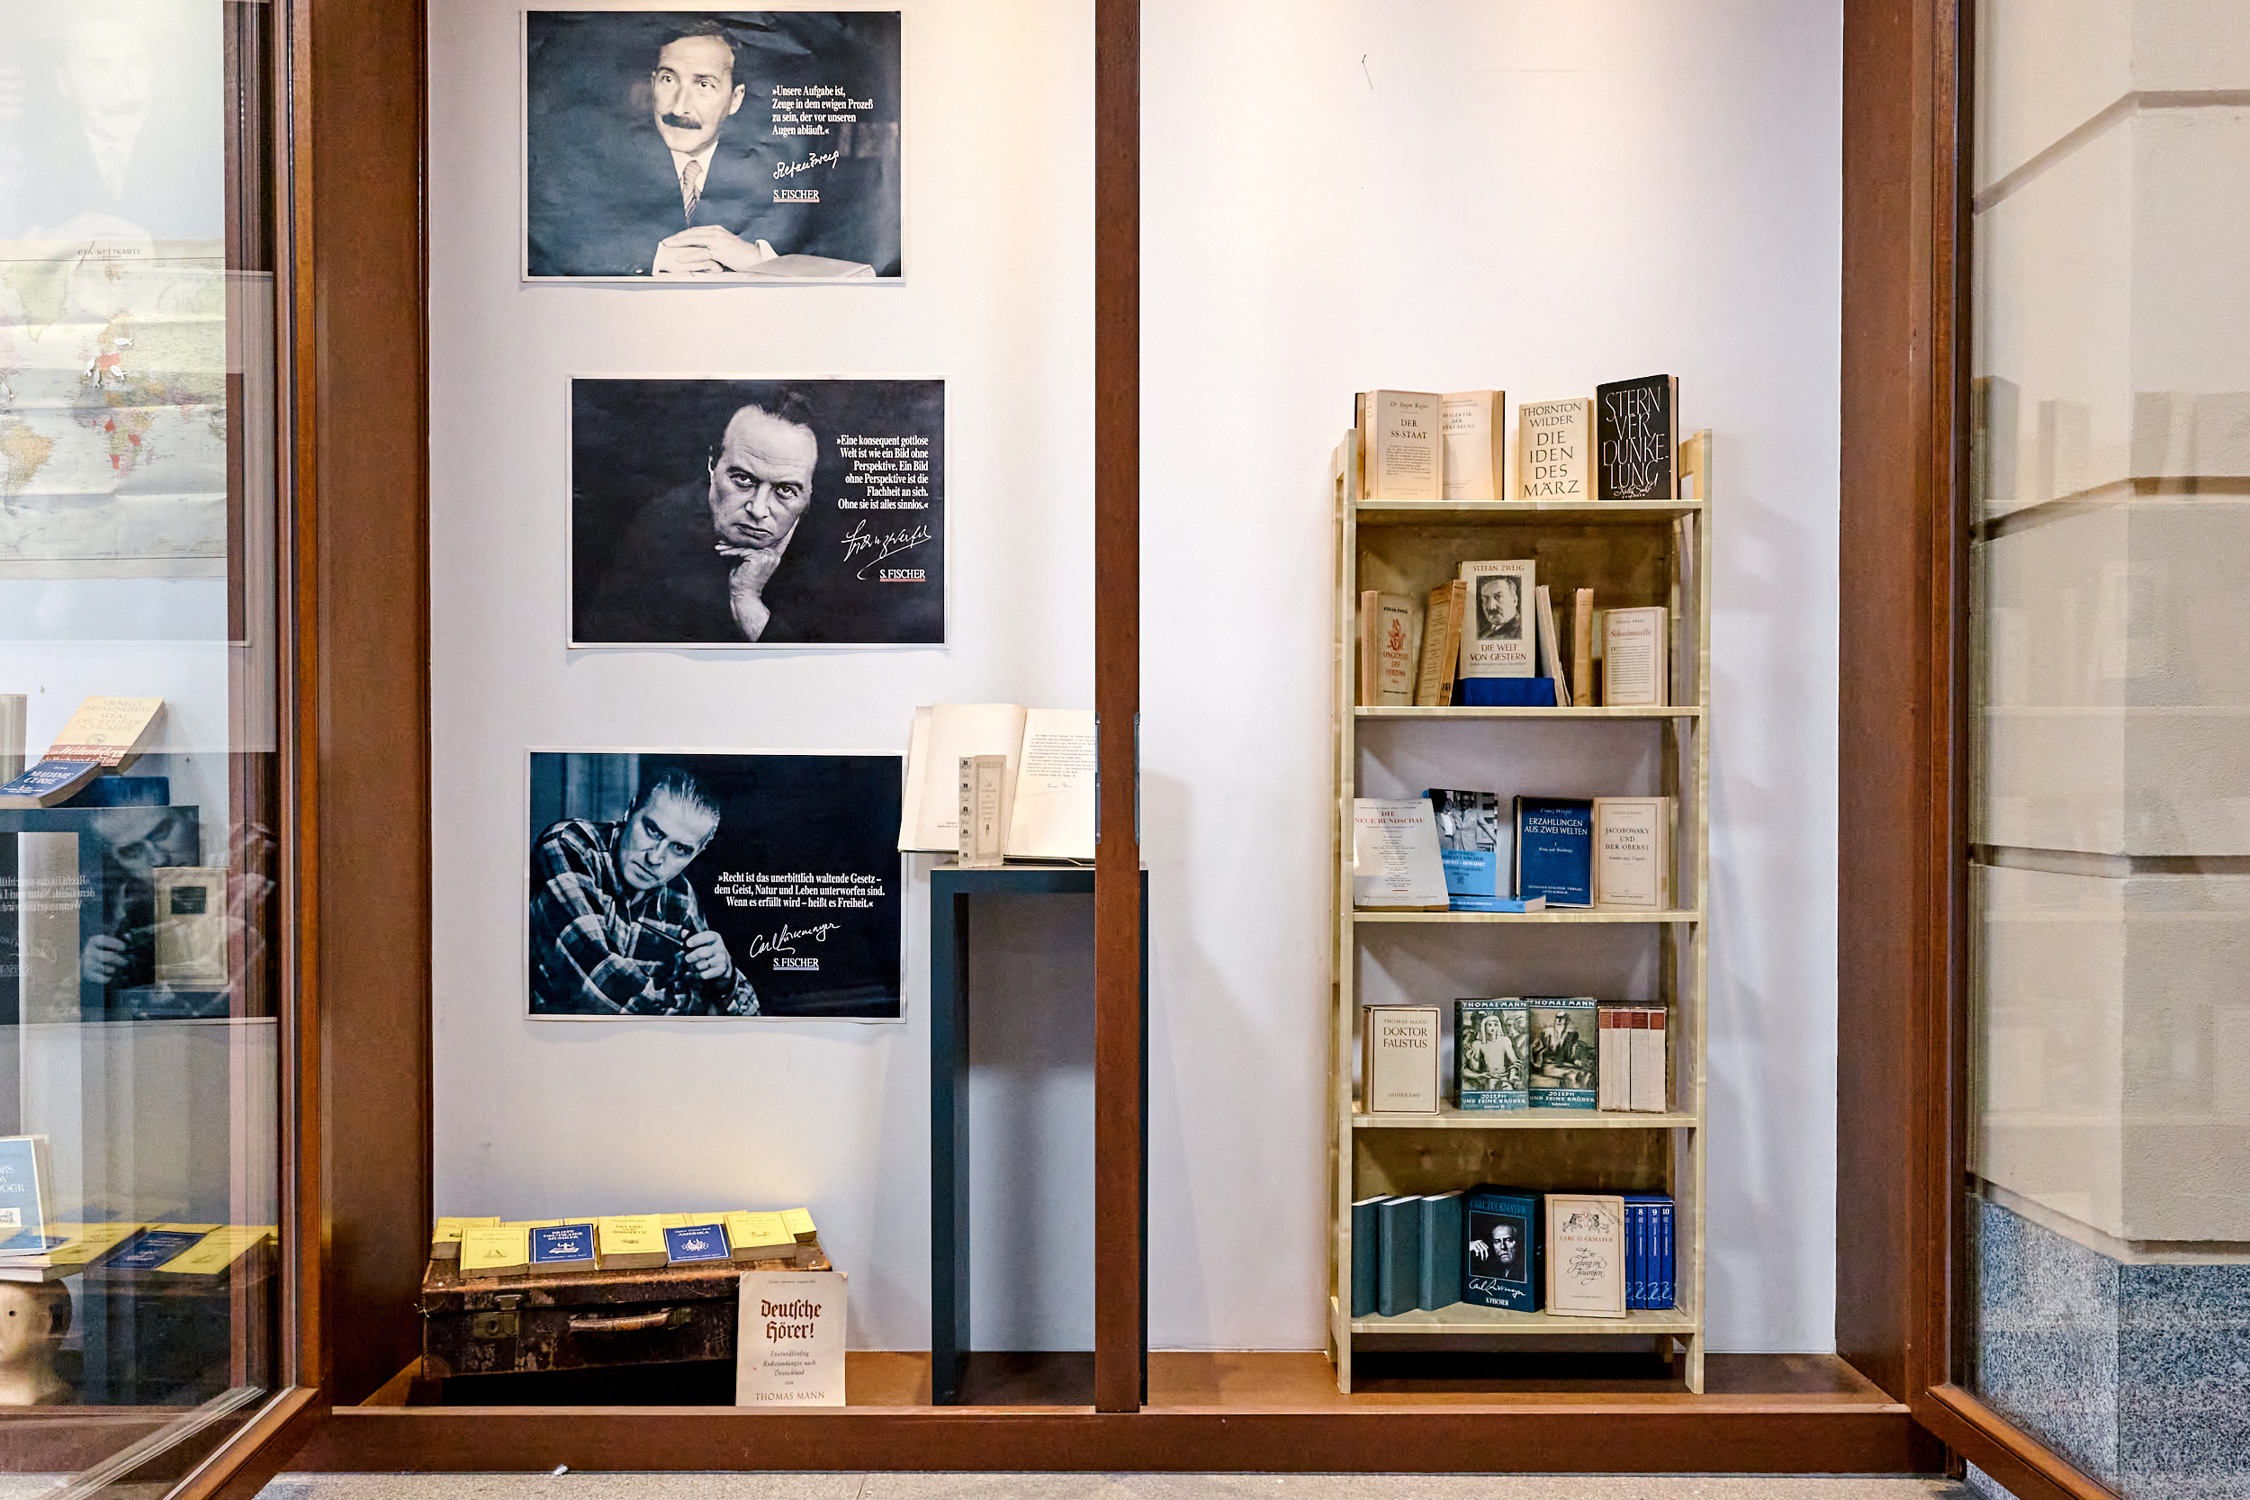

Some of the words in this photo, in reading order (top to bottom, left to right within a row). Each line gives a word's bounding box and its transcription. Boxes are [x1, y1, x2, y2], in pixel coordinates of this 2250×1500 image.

[772, 85, 801, 96] »Unsere
[803, 85, 834, 98] Aufgabe
[834, 86, 846, 97] ist,
[772, 100, 795, 111] Zeuge
[796, 100, 803, 109] in
[804, 100, 820, 109] dem
[822, 100, 846, 111] ewigen
[848, 100, 874, 109] Prozeß
[772, 114, 780, 122] zu
[782, 112, 798, 123] sein,
[800, 112, 812, 122] der
[814, 114, 826, 122] vor
[828, 114, 856, 122] unseren
[772, 126, 796, 137] Augen
[797, 125, 830, 136] abläuft.«
[1522, 403, 1581, 417] THORNTON
[1605, 386, 1661, 422] STERN
[1401, 419, 1417, 427] DER
[1530, 415, 1574, 427] WILDER
[1614, 412, 1656, 440] VER
[1390, 430, 1427, 439] SS-STAAT
[1537, 431, 1566, 446] DIE
[836, 435, 858, 446] »Eine
[859, 435, 900, 448] konsequent
[901, 435, 928, 448] gottlose
[840, 448, 857, 458] Welt
[858, 448, 867, 458] ist
[868, 448, 881, 458] wie
[882, 448, 893, 458] ein
[895, 448, 909, 458] Bild
[911, 448, 928, 458] ohne
[1530, 447, 1573, 463] IDEN
[854, 461, 898, 473] Perspektive.
[900, 461, 912, 471] Ein
[913, 461, 928, 471] Bild
[1535, 464, 1567, 480] DES
[845, 474, 863, 484] ohne
[864, 474, 906, 486] Perspektive
[908, 474, 916, 484] ist
[917, 474, 928, 484] die
[1610, 460, 1658, 490] LUNG
[867, 486, 900, 496] Flachheit
[912, 486, 928, 496] sich.
[1524, 480, 1580, 498] MÄRZ
[838, 498, 858, 509] Ohne
[859, 498, 869, 509] sie
[870, 498, 879, 509] ist
[880, 498, 896, 509] alles
[897, 498, 928, 509] sinnlos.«
[28, 771, 74, 779] MADAME
[718, 872, 744, 882] »Recht
[746, 872, 754, 882] ist
[756, 873, 769, 883] das
[771, 872, 814, 883] unerbittlich
[816, 873, 849, 883] waltende
[851, 873, 875, 883] Gesetz
[714, 884, 730, 894] dem
[732, 885, 754, 896] Geist,
[755, 884, 778, 895] Natur
[779, 884, 793, 895] und
[795, 884, 818, 895] Leben
[820, 885, 866, 896] unterworfen
[867, 885, 885, 896] sind.
[726, 897, 748, 907] Wenn
[758, 897, 782, 907] erfüllt
[783, 897, 800, 907] wird
[808, 897, 827, 907] heißt
[838, 898, 873, 908] Freiheit.«
[1384, 1027, 1428, 1036] DOKTOR
[1384, 1039, 1428, 1048] FAUSTUS
[766, 1321, 814, 1344] Hörer!
[756, 1392, 794, 1401] THOMAS
